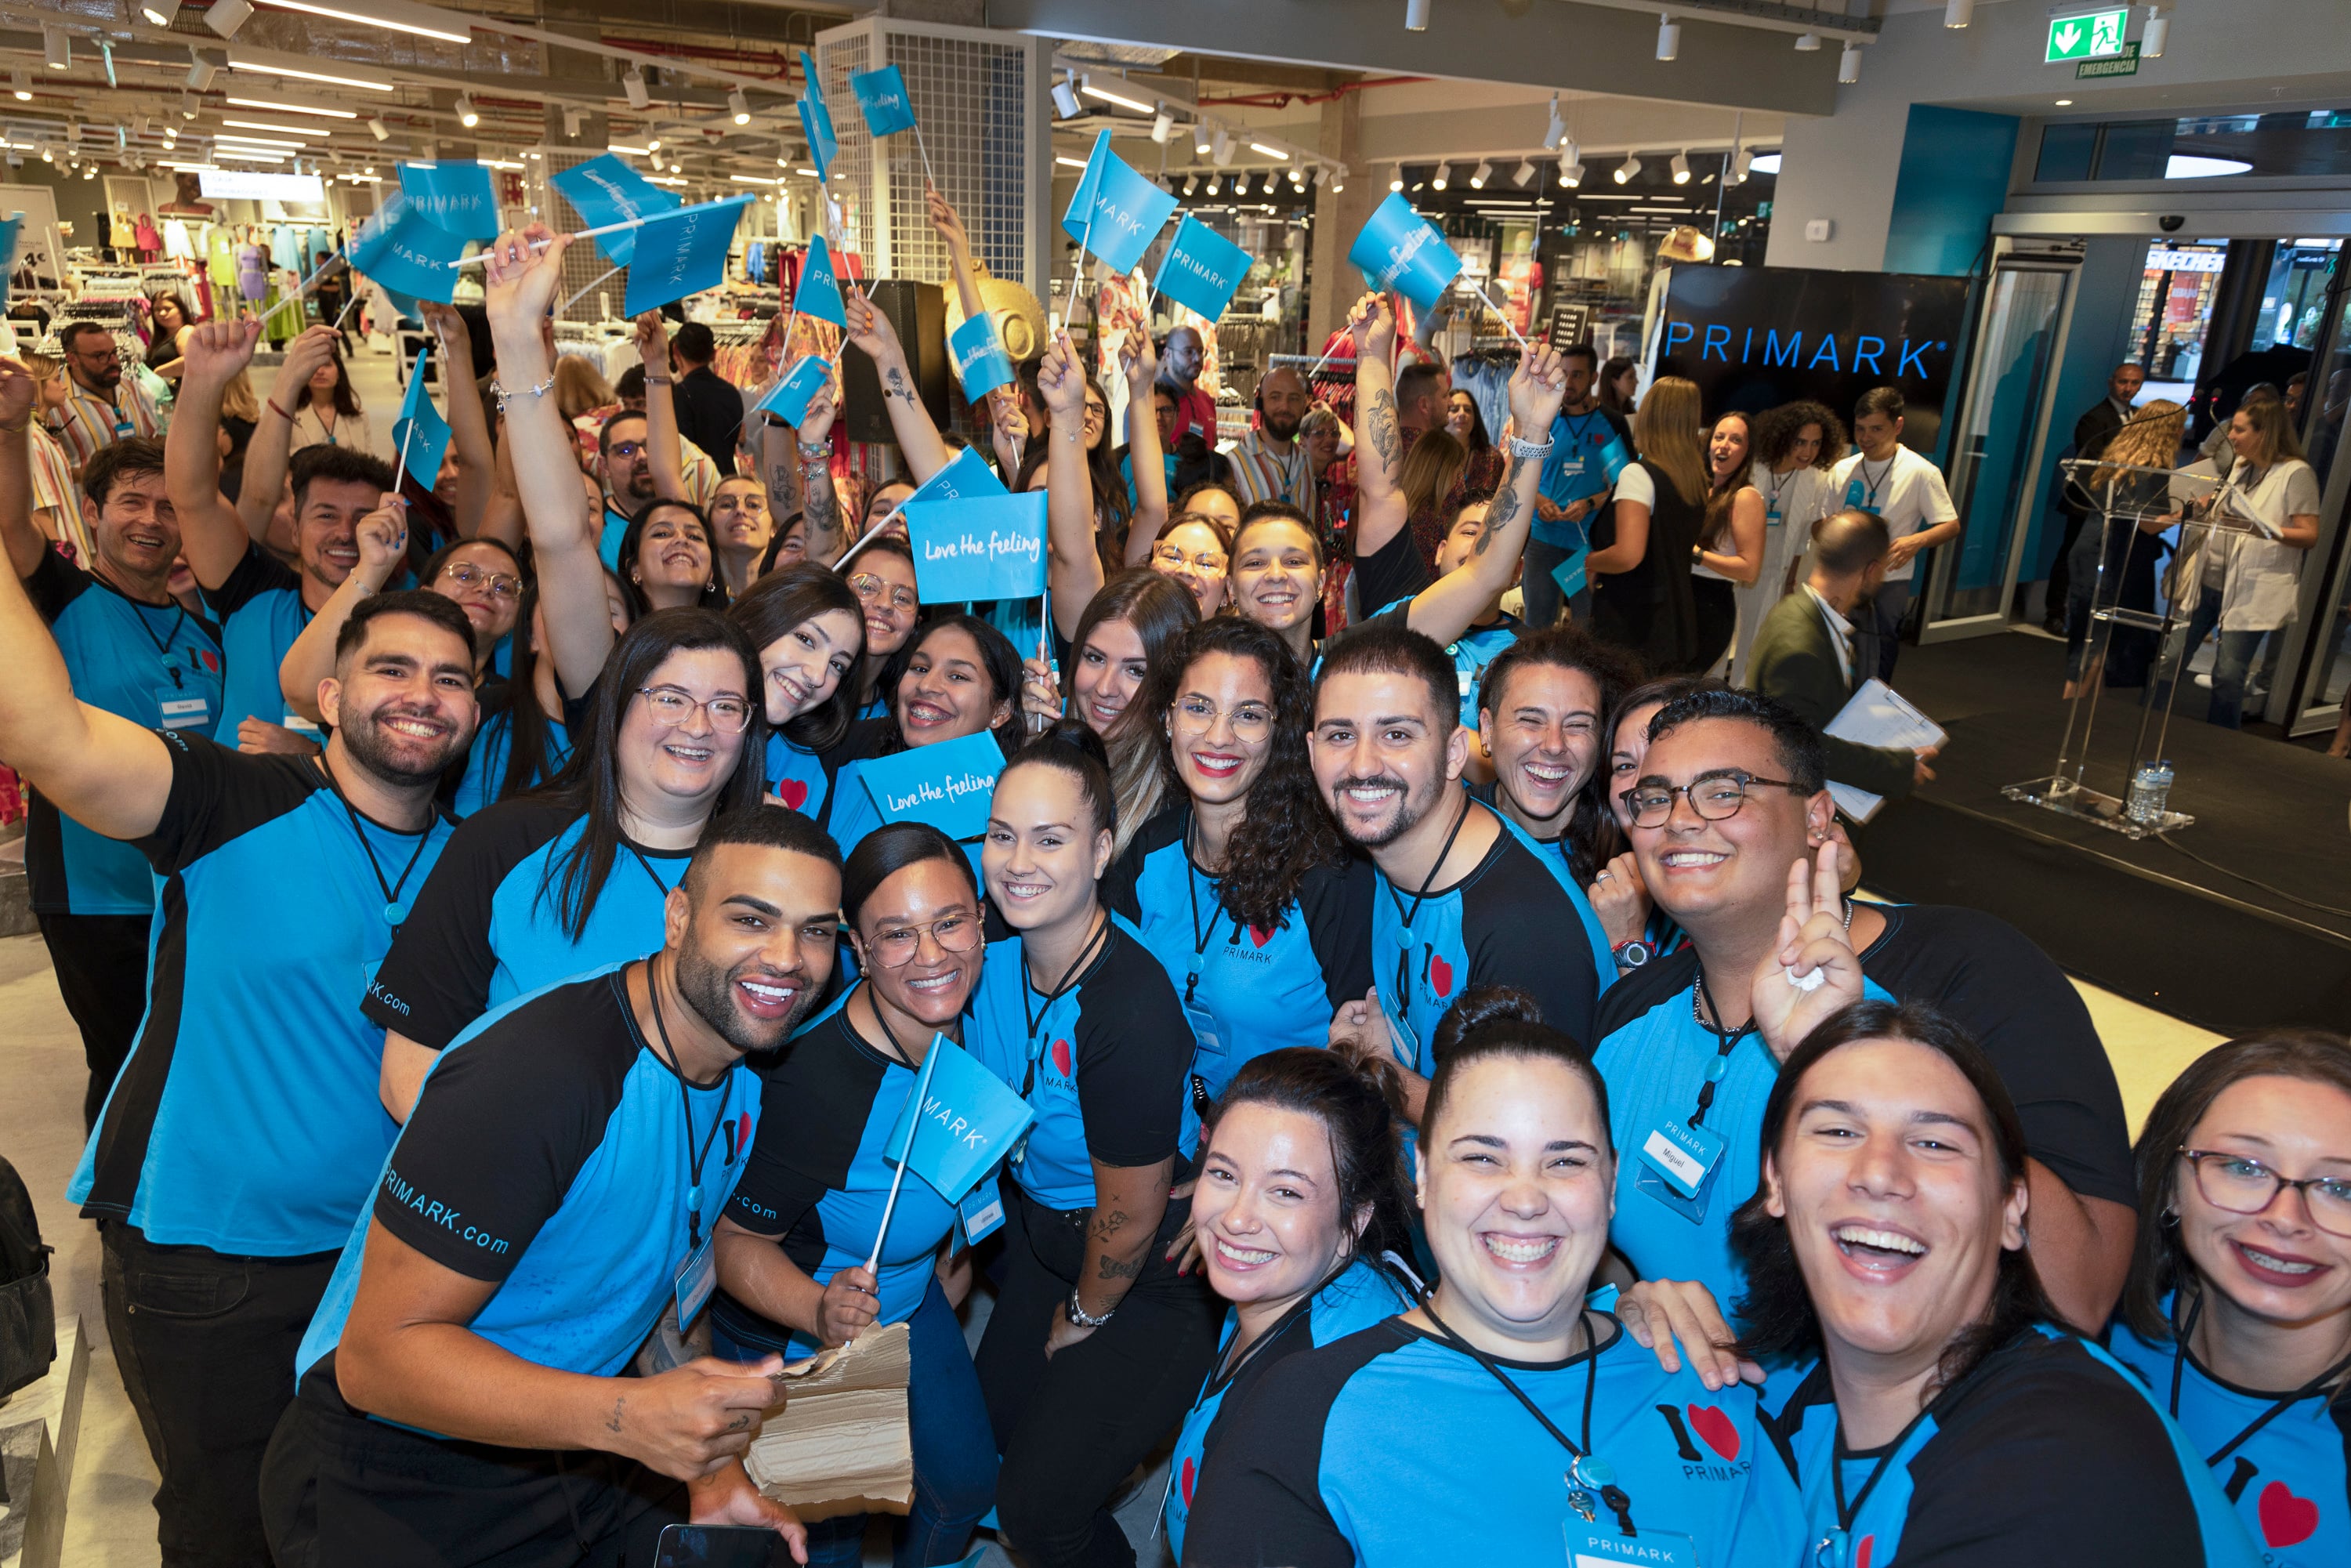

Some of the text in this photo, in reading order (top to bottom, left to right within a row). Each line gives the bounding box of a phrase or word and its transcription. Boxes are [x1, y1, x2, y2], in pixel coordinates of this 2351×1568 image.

[2079, 60, 2136, 76] EMERGENCIA
[668, 212, 698, 284] PRIMARK
[1171, 248, 1223, 282] PRIMARK
[1665, 322, 1934, 379] PRIMARK
[926, 531, 1041, 563] Love the feeling
[887, 773, 996, 812] Love the feeling
[1223, 946, 1272, 965] PRIMARK
[1421, 942, 1433, 985] I
[922, 1095, 984, 1150] MARK
[1665, 1120, 1706, 1157] PRIMARK
[723, 1119, 737, 1167] I
[1662, 1145, 1685, 1168] Miguel
[734, 1193, 777, 1219] .com
[968, 1192, 993, 1211] PRIMARK
[1655, 1404, 1704, 1461] I
[1588, 1537, 1675, 1563] PRIMARK
